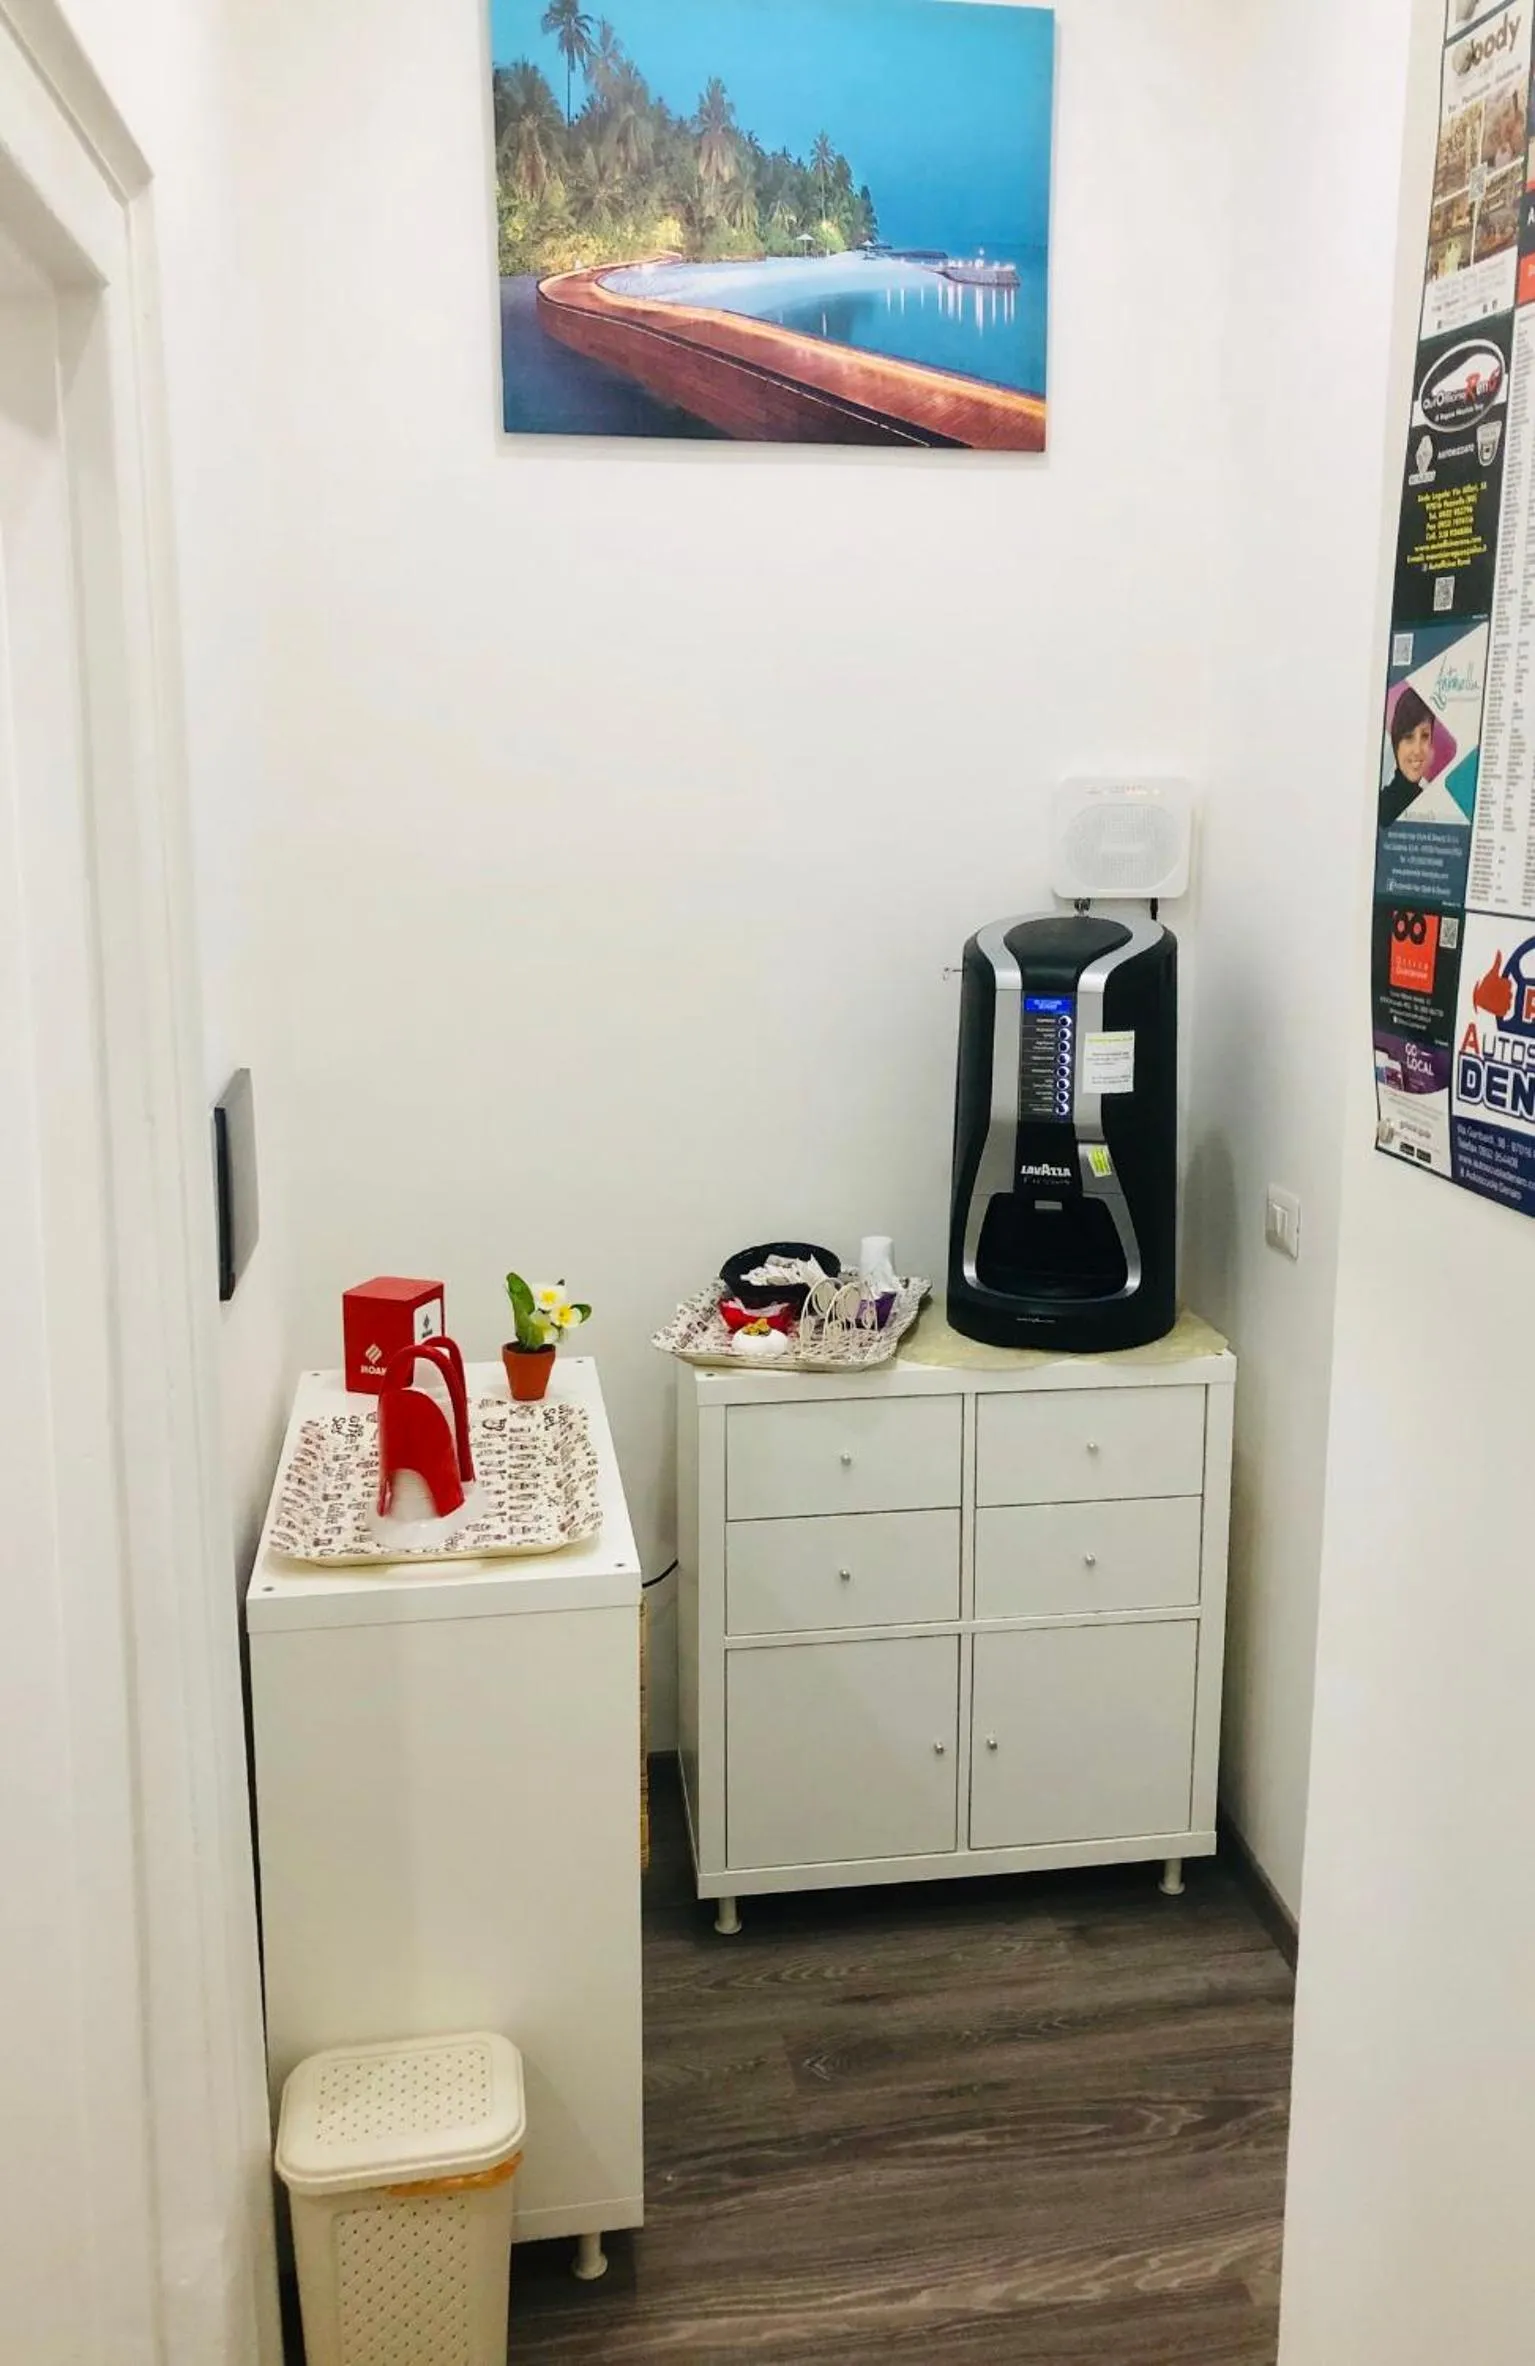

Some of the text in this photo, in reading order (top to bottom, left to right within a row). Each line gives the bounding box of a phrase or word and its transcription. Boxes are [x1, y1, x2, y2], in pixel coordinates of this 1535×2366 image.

[1471, 12, 1521, 66] body
[1406, 1055, 1434, 1076] LOCAL
[1020, 1163, 1071, 1177] LAVAZZA
